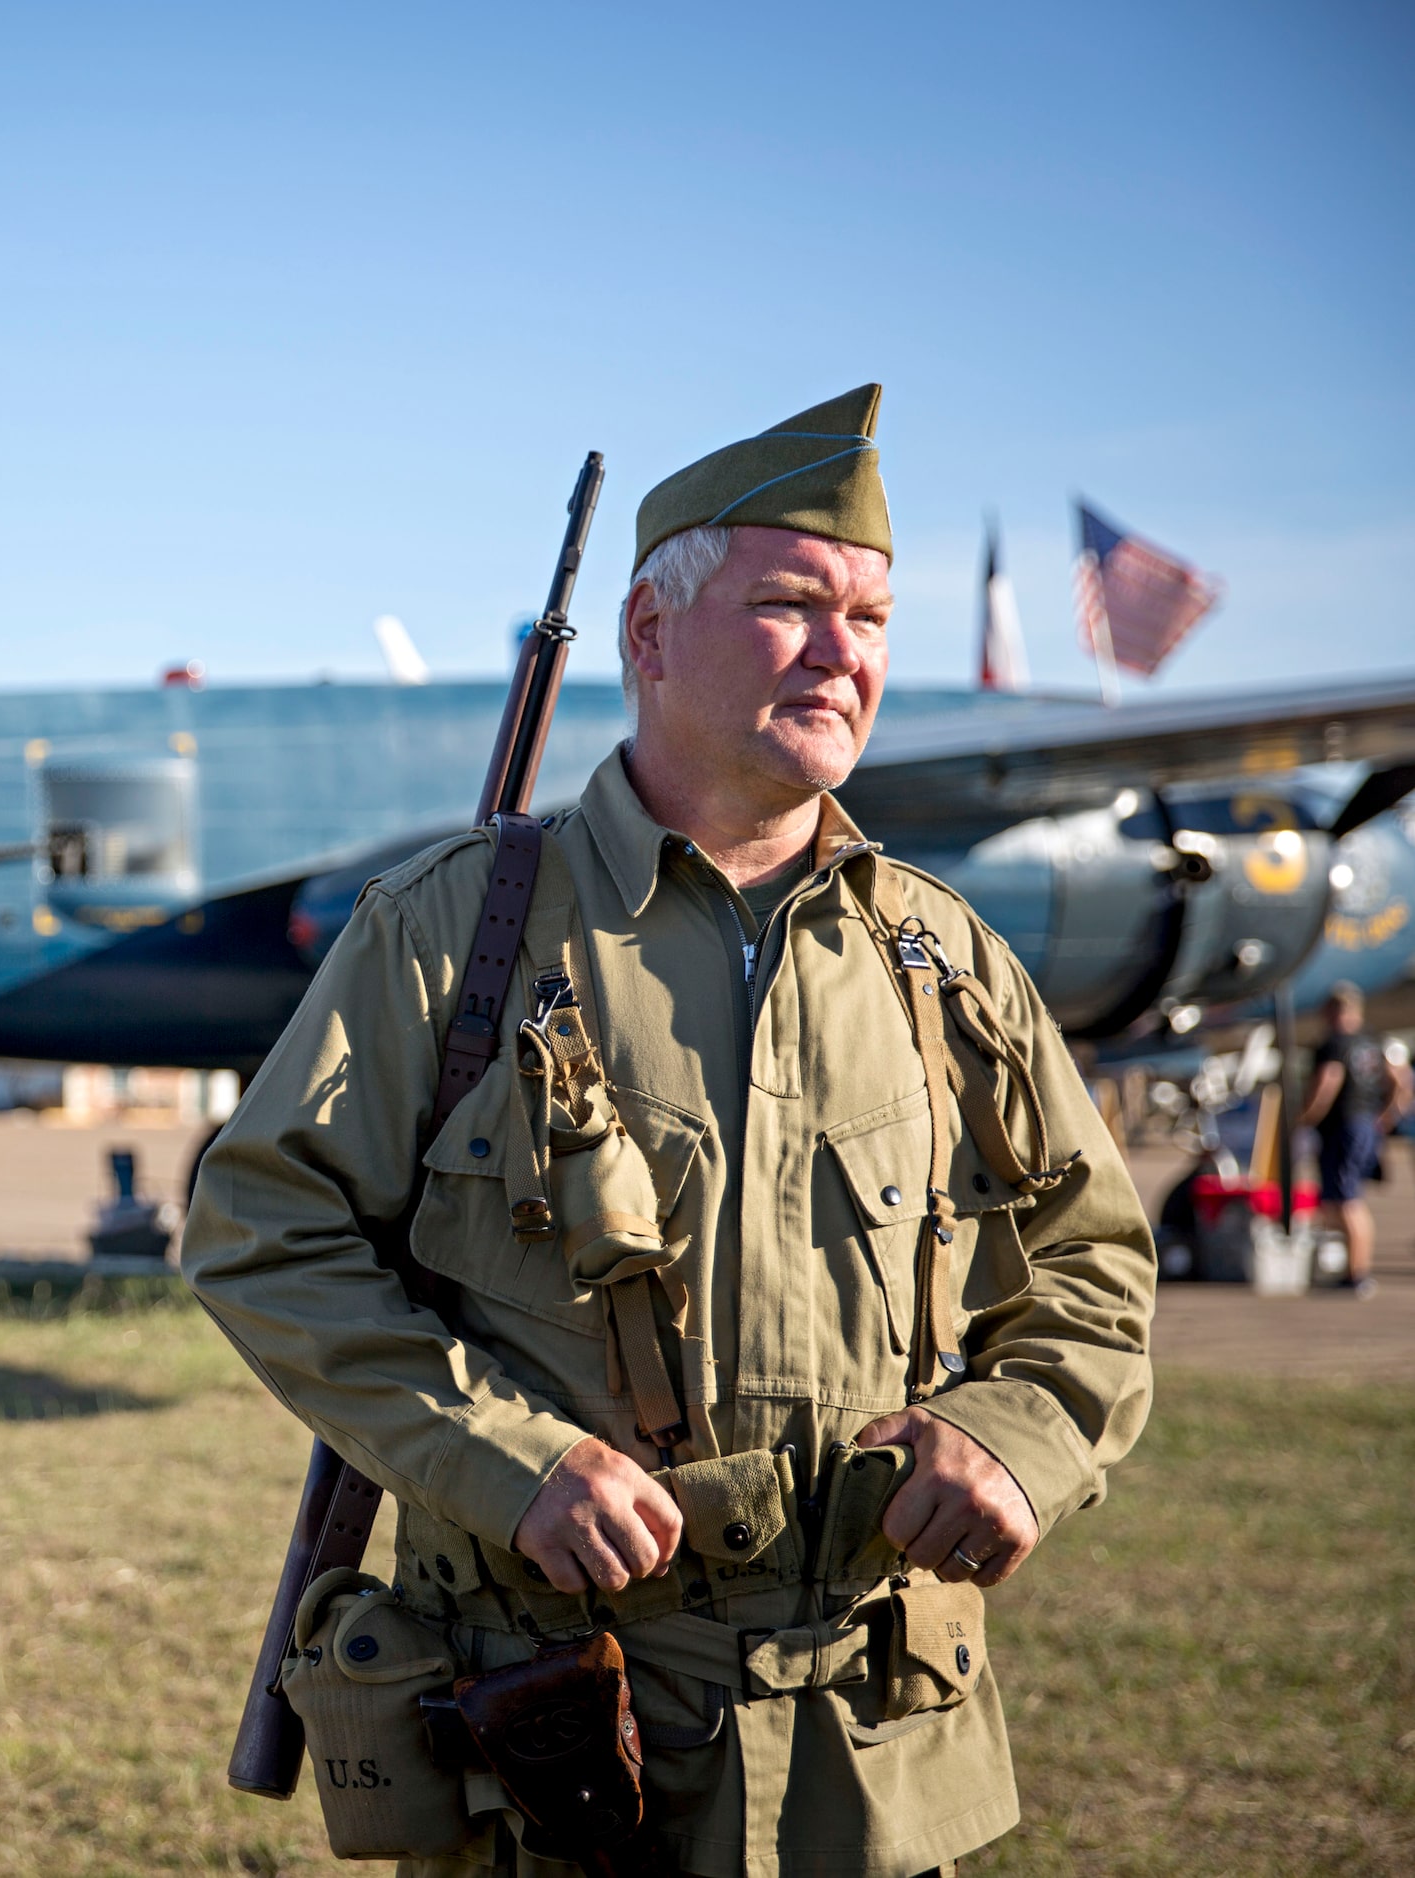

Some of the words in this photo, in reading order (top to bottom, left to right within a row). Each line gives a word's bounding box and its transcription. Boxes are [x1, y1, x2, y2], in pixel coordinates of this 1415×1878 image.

[1231, 792, 1306, 894] 3
[717, 1557, 776, 1581] U.S.
[945, 1621, 966, 1639] U.S.
[325, 1758, 392, 1789] U.S.
